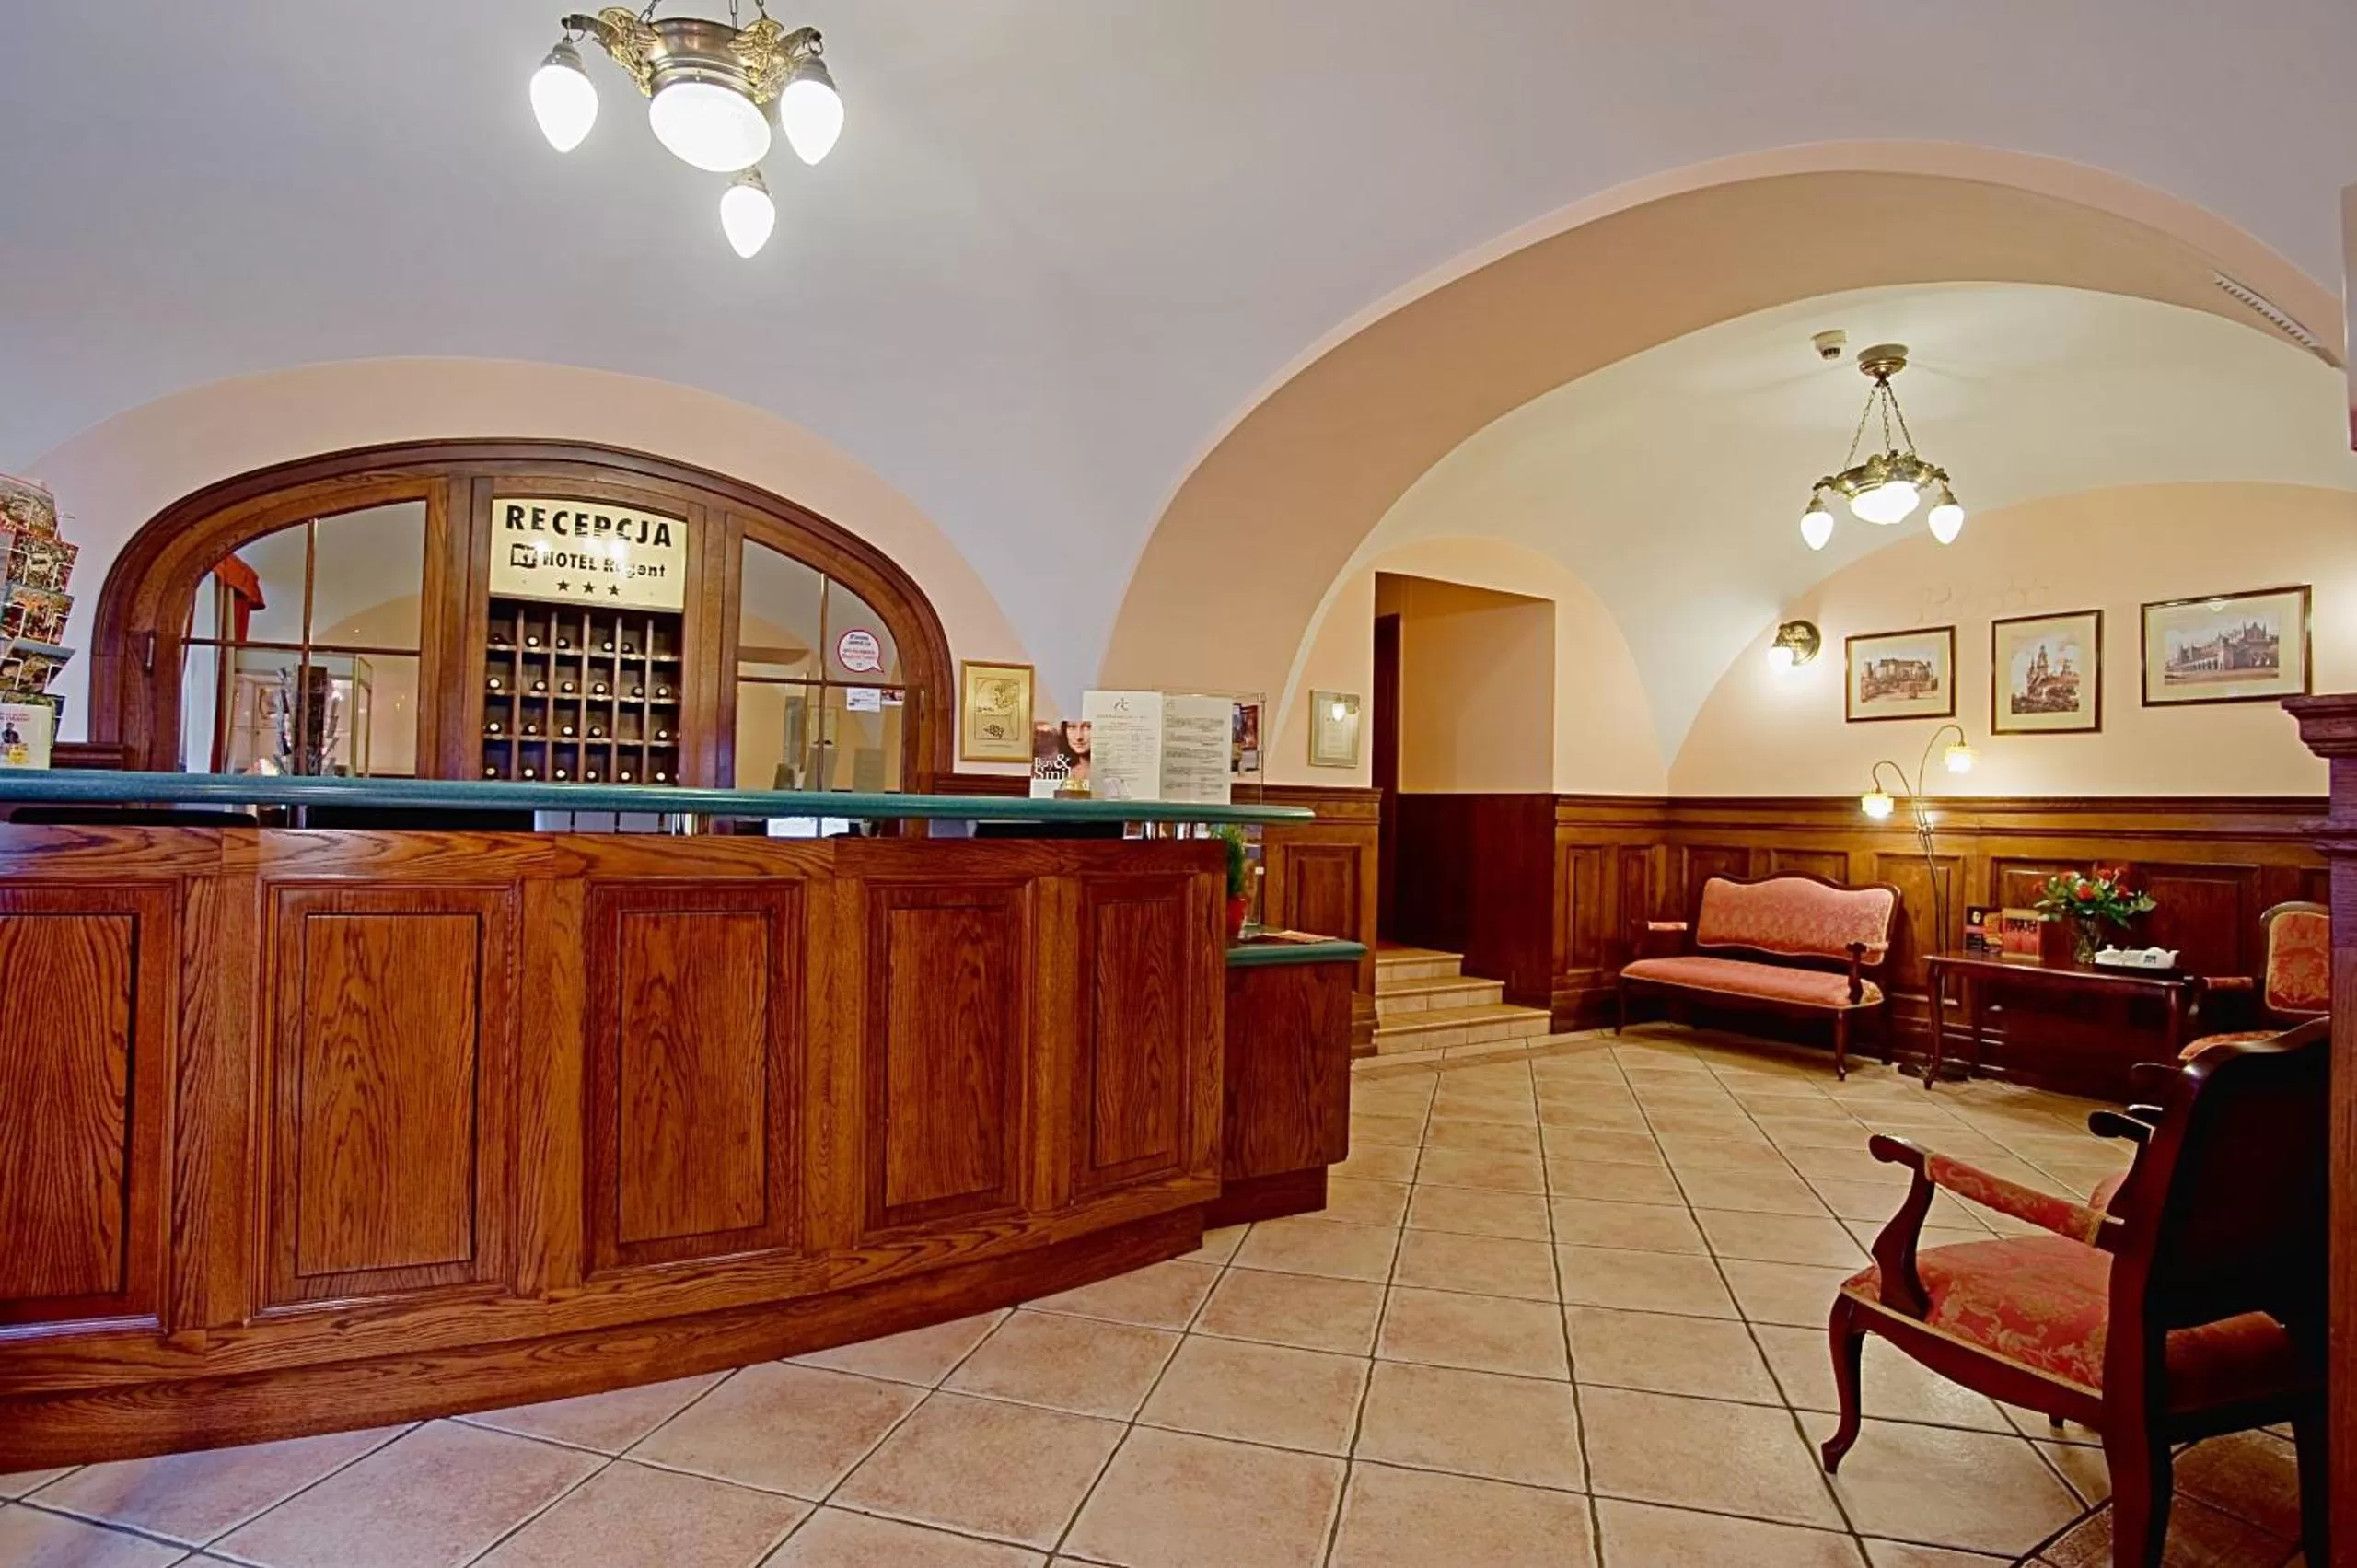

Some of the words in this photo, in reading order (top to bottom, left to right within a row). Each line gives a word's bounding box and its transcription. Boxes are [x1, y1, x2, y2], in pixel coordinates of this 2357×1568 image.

[505, 505, 672, 548] RECEPCJA
[542, 551, 598, 572] HOTEL
[603, 557, 666, 579] Rgent
